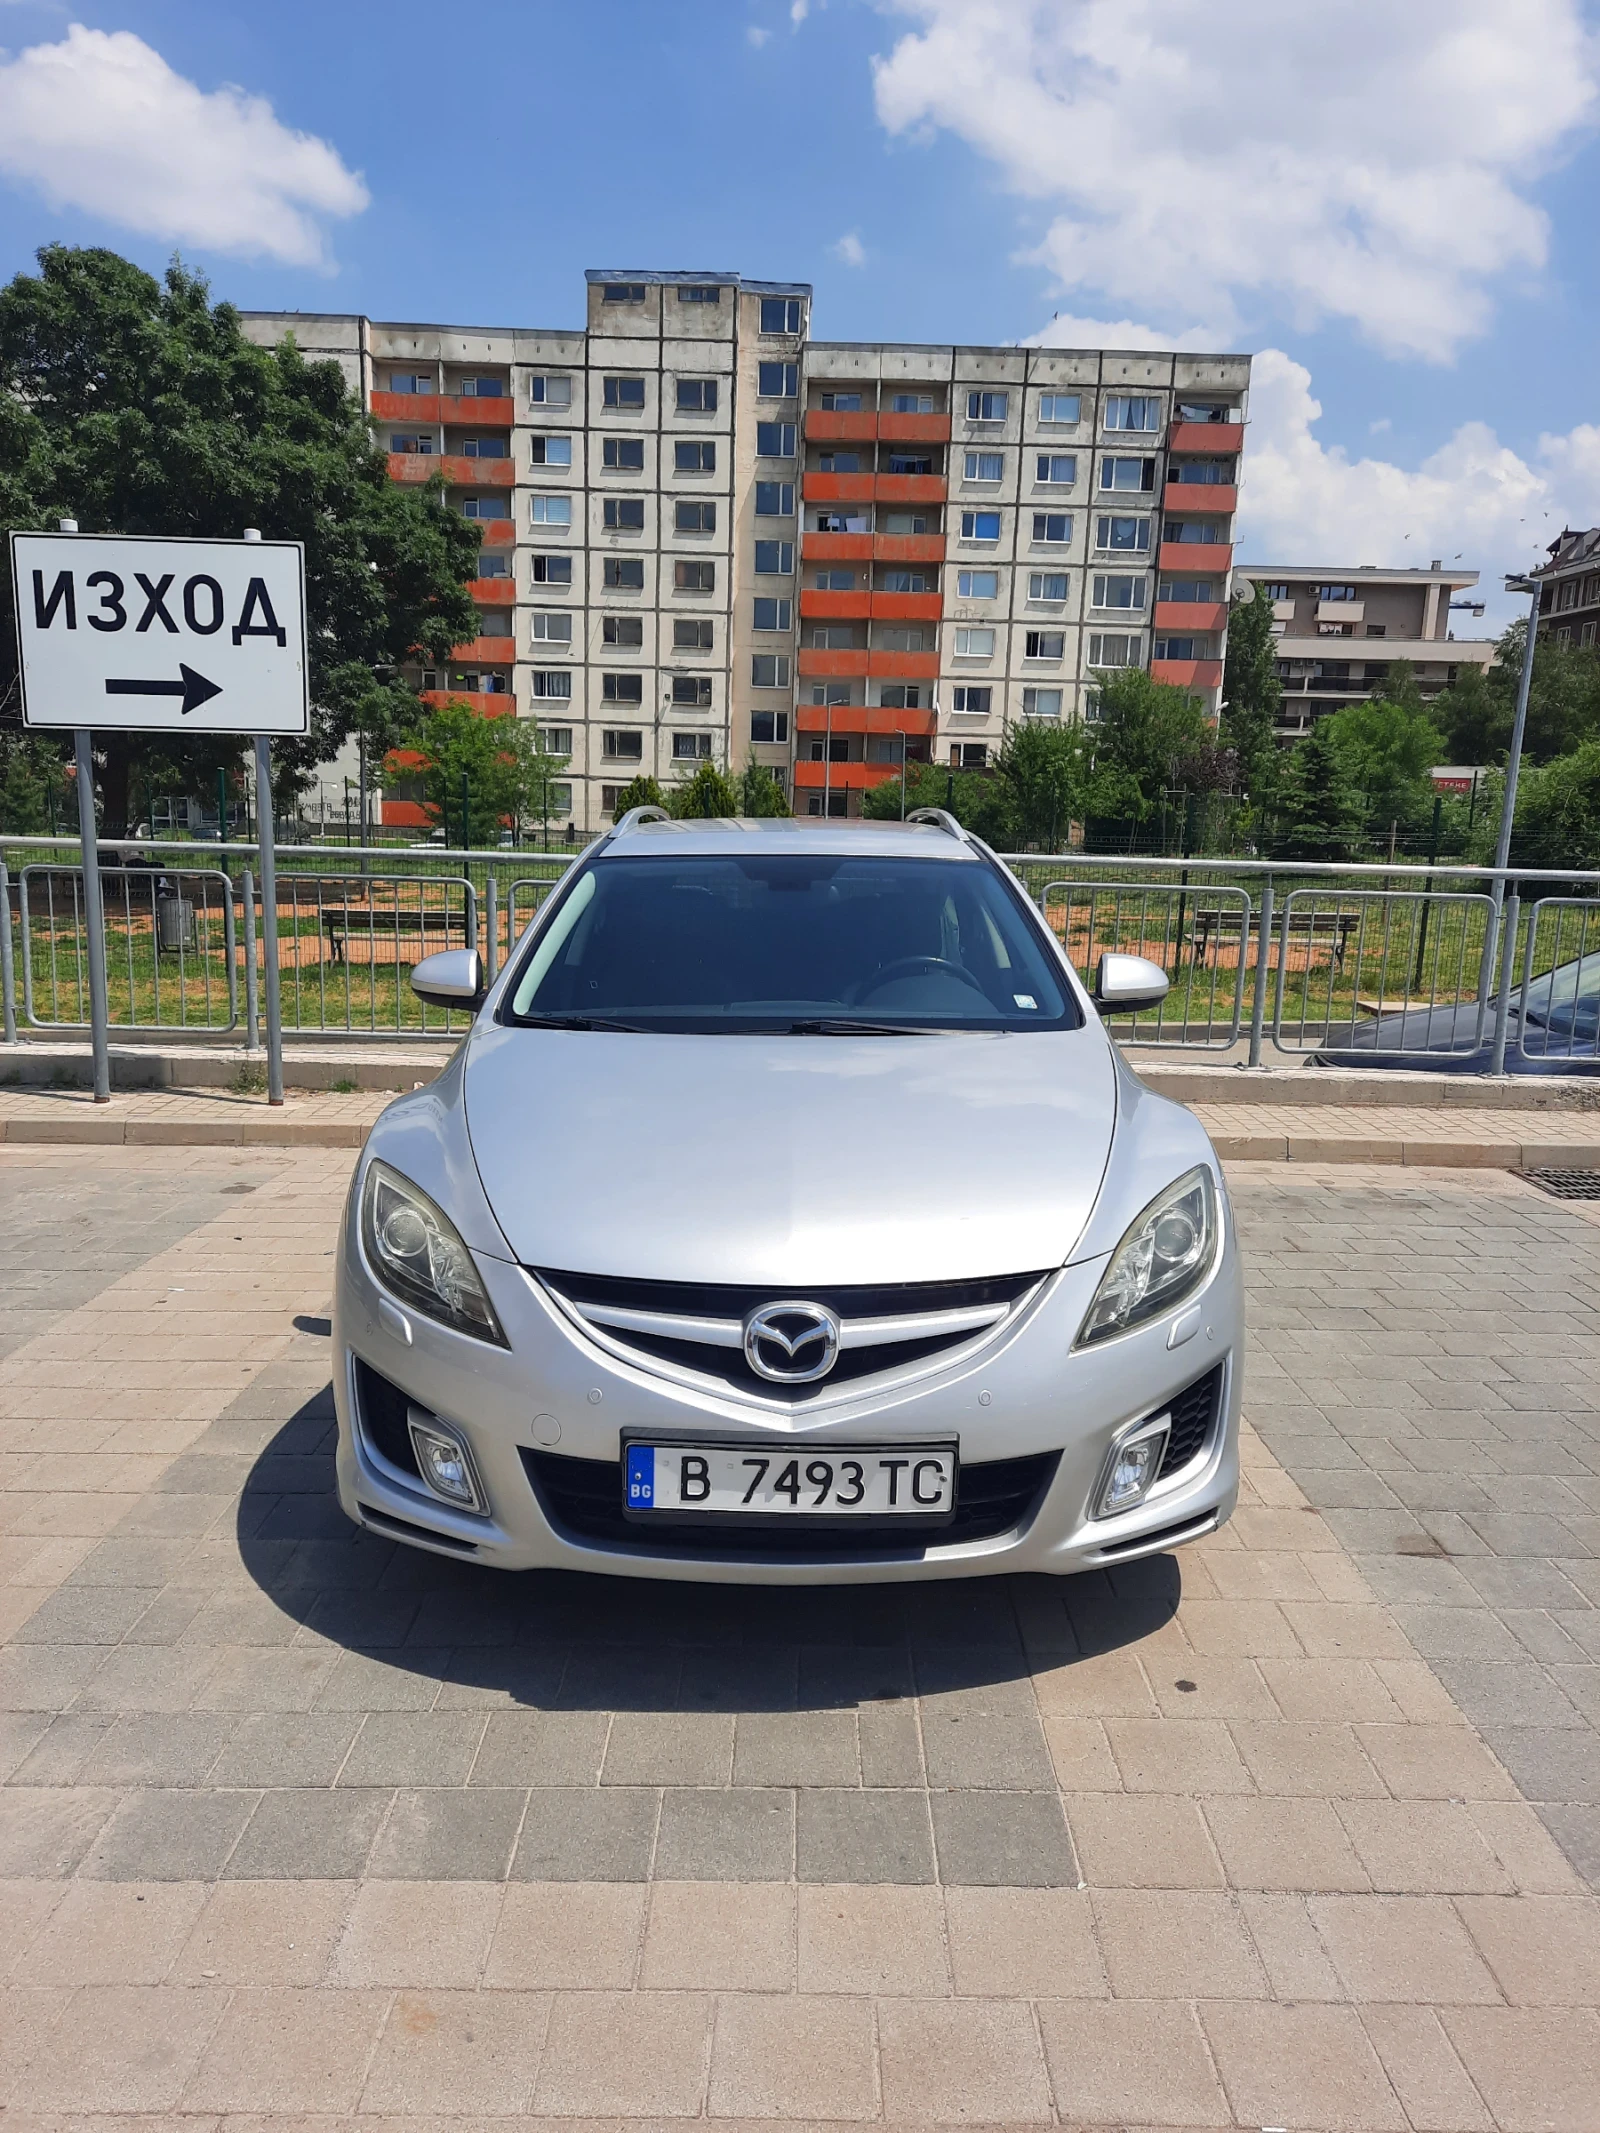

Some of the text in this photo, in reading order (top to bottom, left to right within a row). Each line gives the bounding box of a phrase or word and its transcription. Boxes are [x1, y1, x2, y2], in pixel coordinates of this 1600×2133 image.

[32, 569, 287, 648] ИЗХОД
[630, 1484, 652, 1499] BG
[680, 1456, 944, 1506] B 7493 TC
